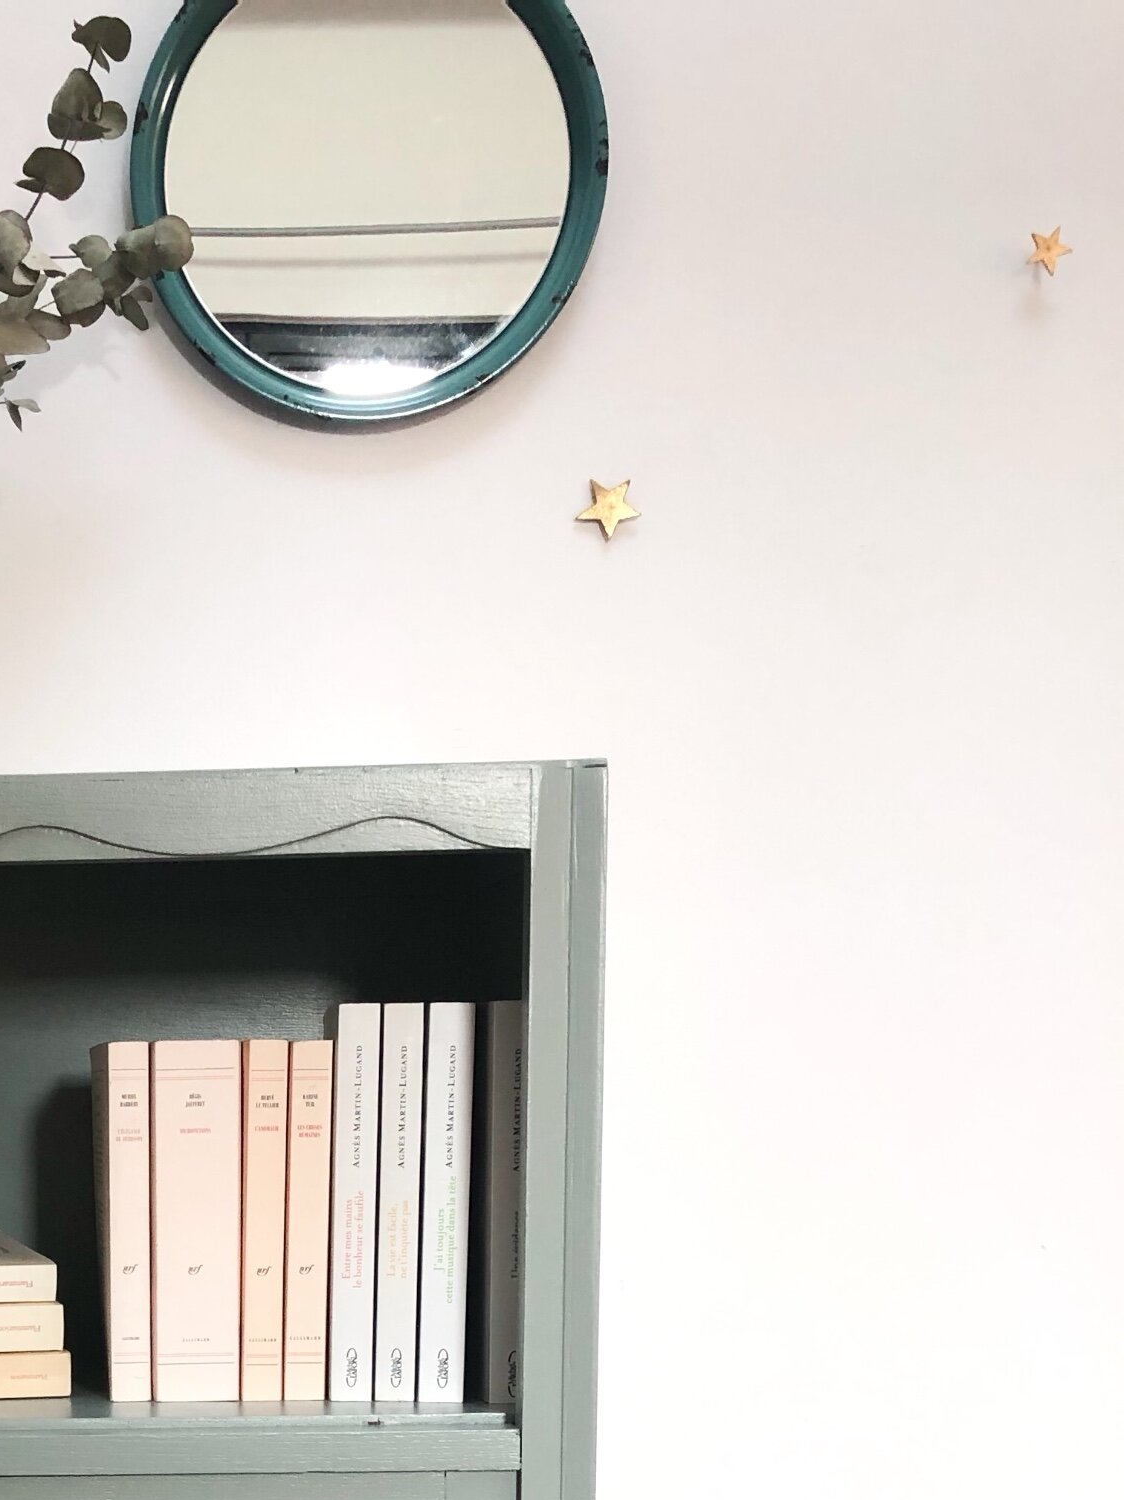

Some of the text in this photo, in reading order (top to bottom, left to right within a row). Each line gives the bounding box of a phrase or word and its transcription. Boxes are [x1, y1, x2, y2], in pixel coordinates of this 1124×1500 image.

[352, 1045, 363, 1168] AGNÈS MARTIN-LUGAND
[396, 1045, 408, 1168] AGNÈS MARTIN-LUGAND
[444, 1044, 456, 1168] AGNÈS MARTIN-LUGAND
[341, 1252, 352, 1279] Entre
[344, 1199, 352, 1229] mains
[352, 1191, 364, 1288] le bonheur se faufile
[433, 1208, 446, 1272] J'ai toujours
[446, 1175, 458, 1304] cette musique dans la tête
